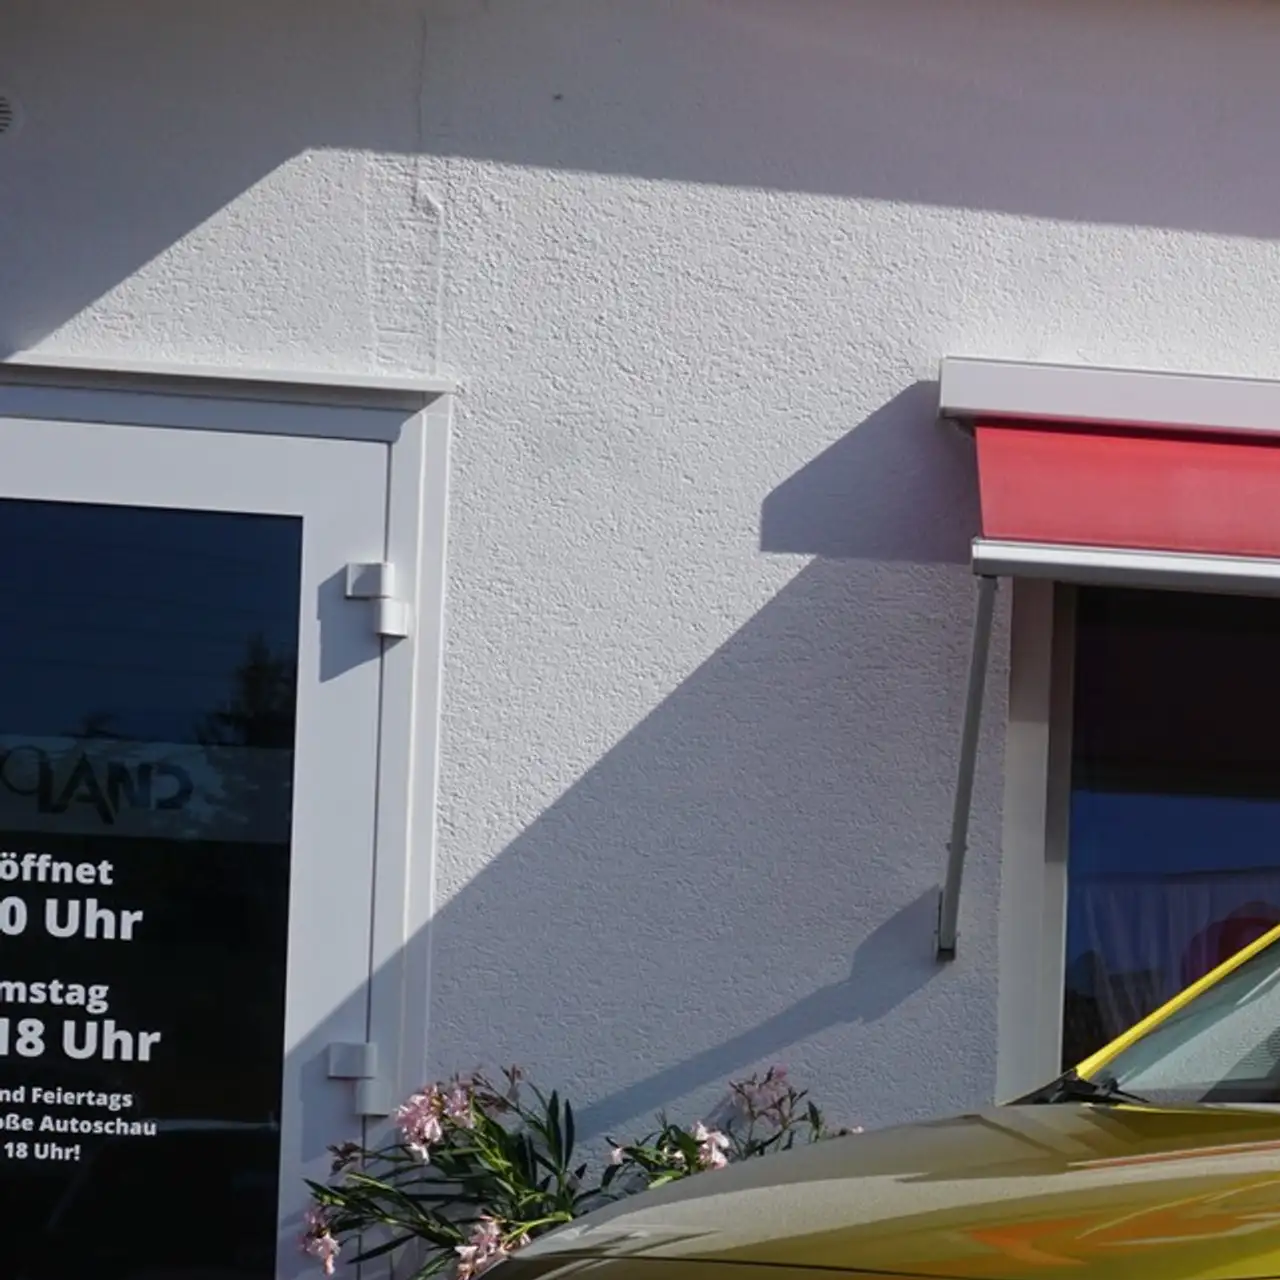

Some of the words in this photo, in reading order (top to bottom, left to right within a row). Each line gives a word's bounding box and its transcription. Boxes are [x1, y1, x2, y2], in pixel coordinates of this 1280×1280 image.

[44, 898, 145, 942] Uhr
[62, 1019, 162, 1062] Uhr
[31, 1086, 133, 1112] Feiertags
[39, 1114, 158, 1136] Autoschau
[3, 1141, 29, 1160] 18
[33, 1142, 82, 1162] Uhr!
